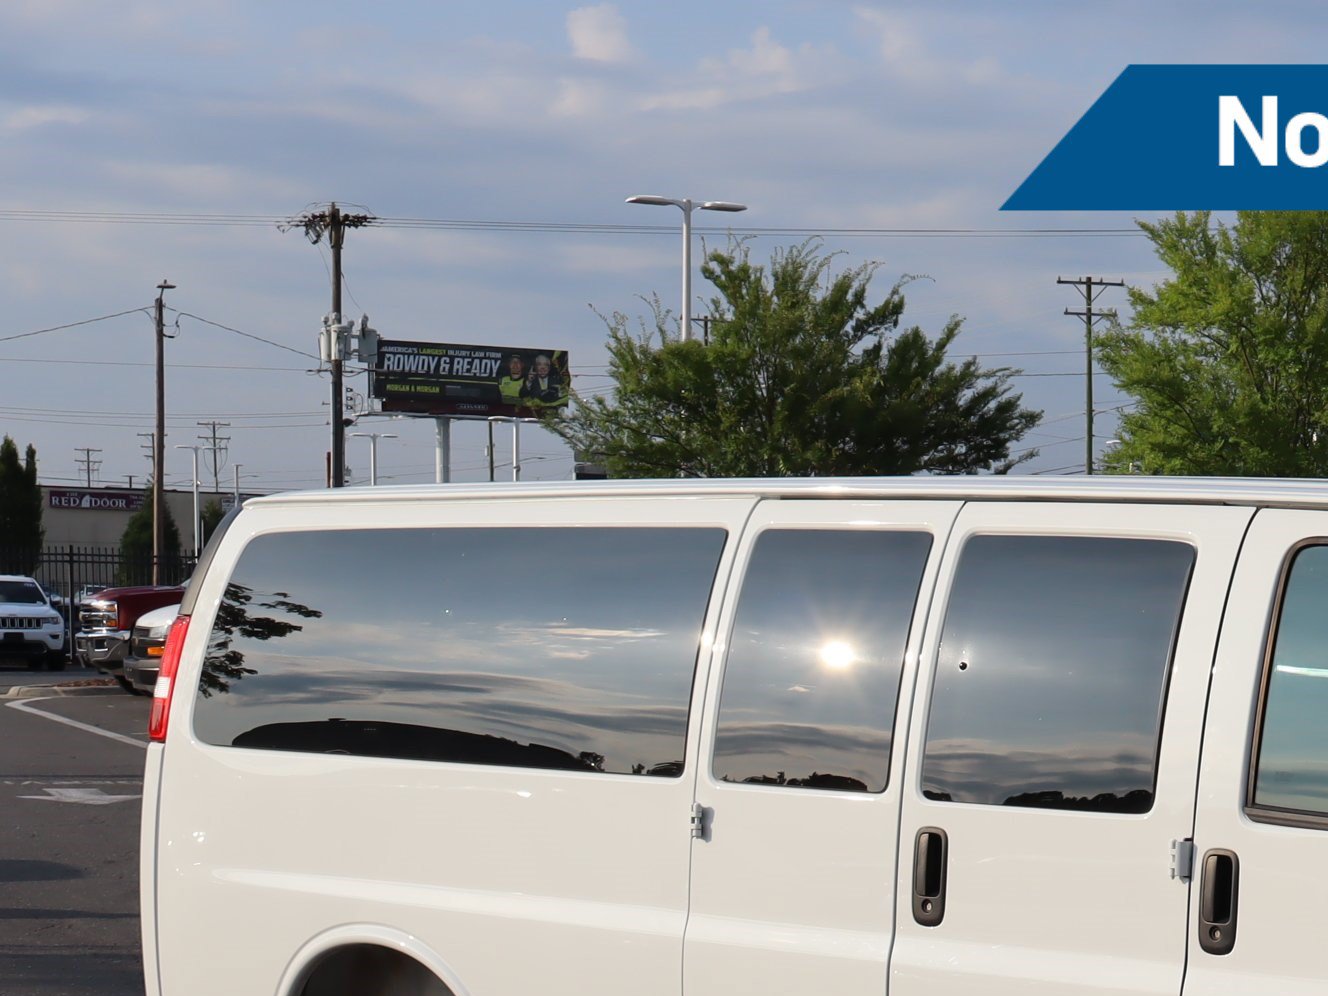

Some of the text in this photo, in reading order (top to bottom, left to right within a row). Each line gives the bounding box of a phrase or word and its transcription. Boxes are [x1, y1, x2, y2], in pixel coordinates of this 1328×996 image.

[419, 347, 447, 355] LARGEST
[471, 350, 484, 358] LAW
[486, 351, 502, 359] FIRM
[384, 353, 501, 378] ROWDY & READY
[386, 384, 410, 392] MORGAN
[416, 385, 440, 394] MORGAN
[51, 495, 80, 508] RED
[91, 497, 127, 509] DOOR
